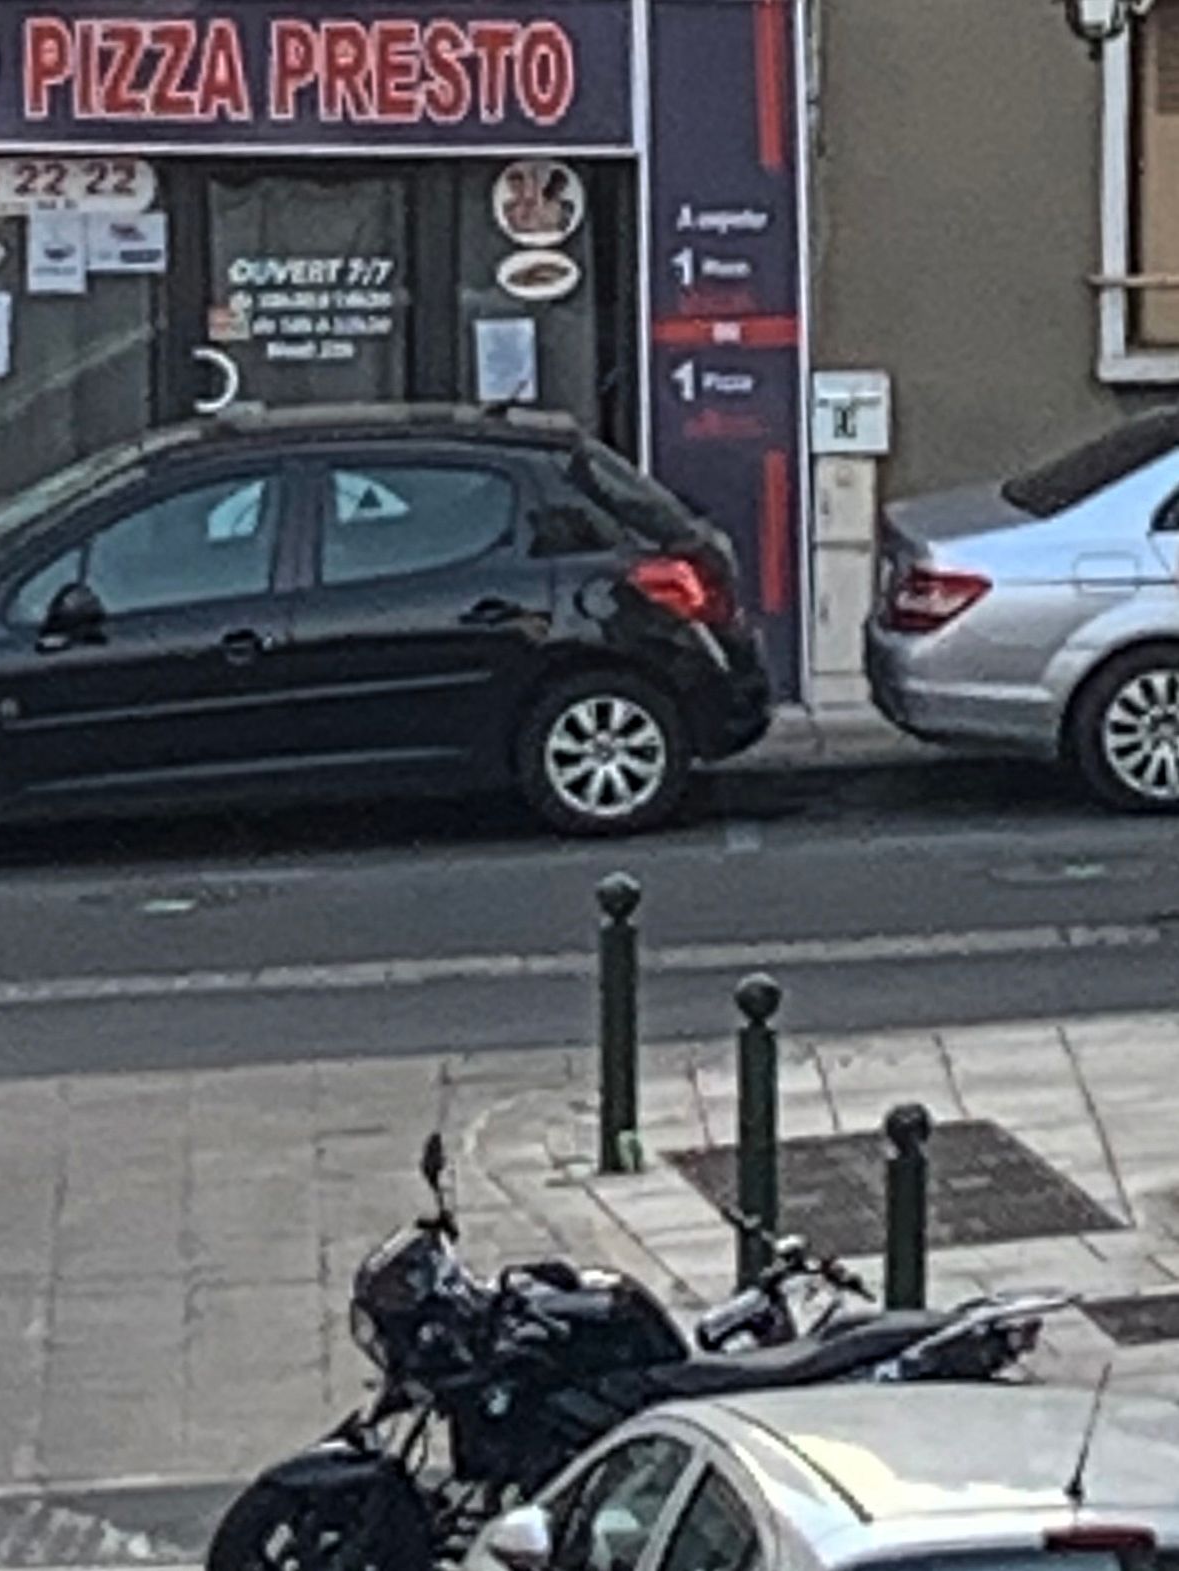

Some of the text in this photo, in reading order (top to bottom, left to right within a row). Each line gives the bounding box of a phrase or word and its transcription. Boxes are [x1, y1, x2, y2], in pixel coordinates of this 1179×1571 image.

[24, 17, 574, 125] PIZZA PRESTO
[15, 164, 69, 196] 22
[85, 163, 137, 196] 22
[228, 258, 393, 285] OUVERT 7/7
[671, 248, 694, 286] 1
[671, 360, 695, 401] 1
